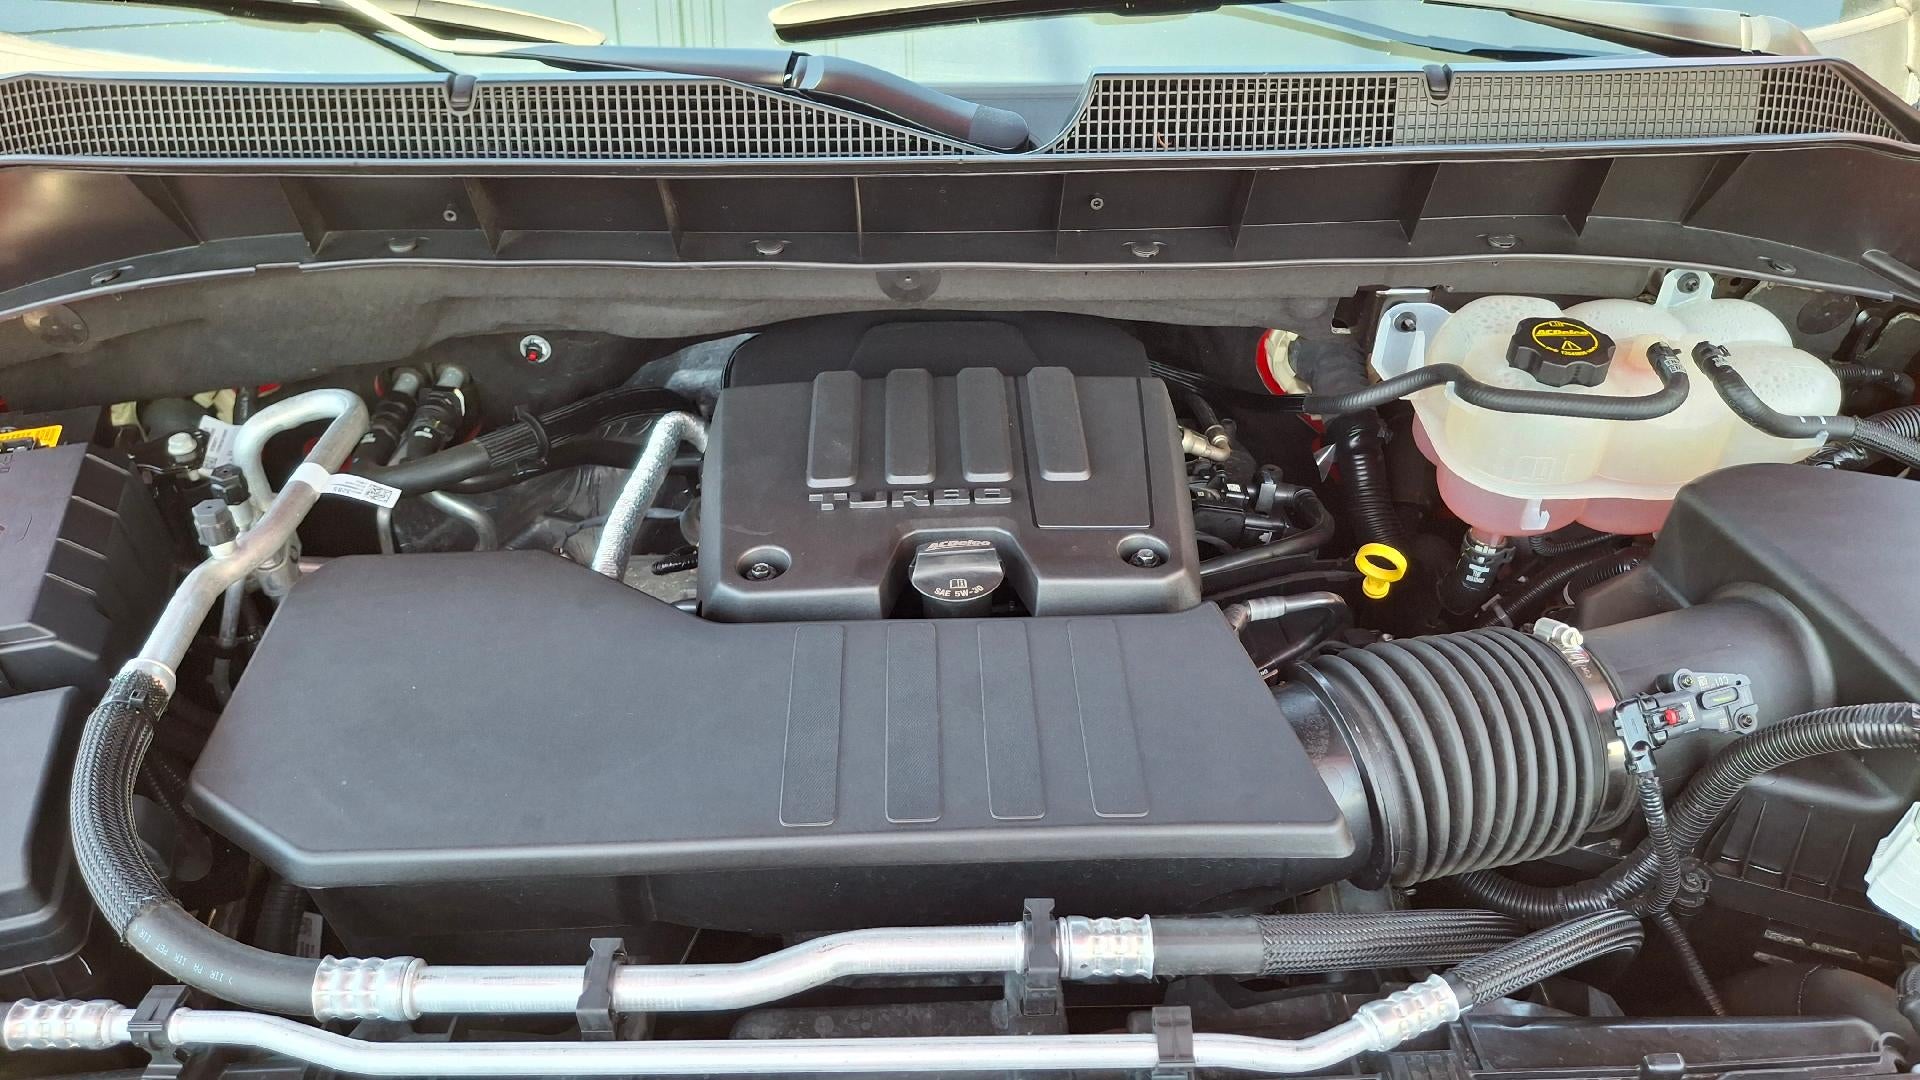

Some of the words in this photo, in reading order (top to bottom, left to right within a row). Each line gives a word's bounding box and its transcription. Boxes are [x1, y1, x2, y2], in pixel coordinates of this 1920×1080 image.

[1535, 329, 1590, 337] ACDelco
[809, 488, 1012, 511] TURBO
[934, 587, 951, 597] SAE
[954, 585, 984, 597] 5W-30
